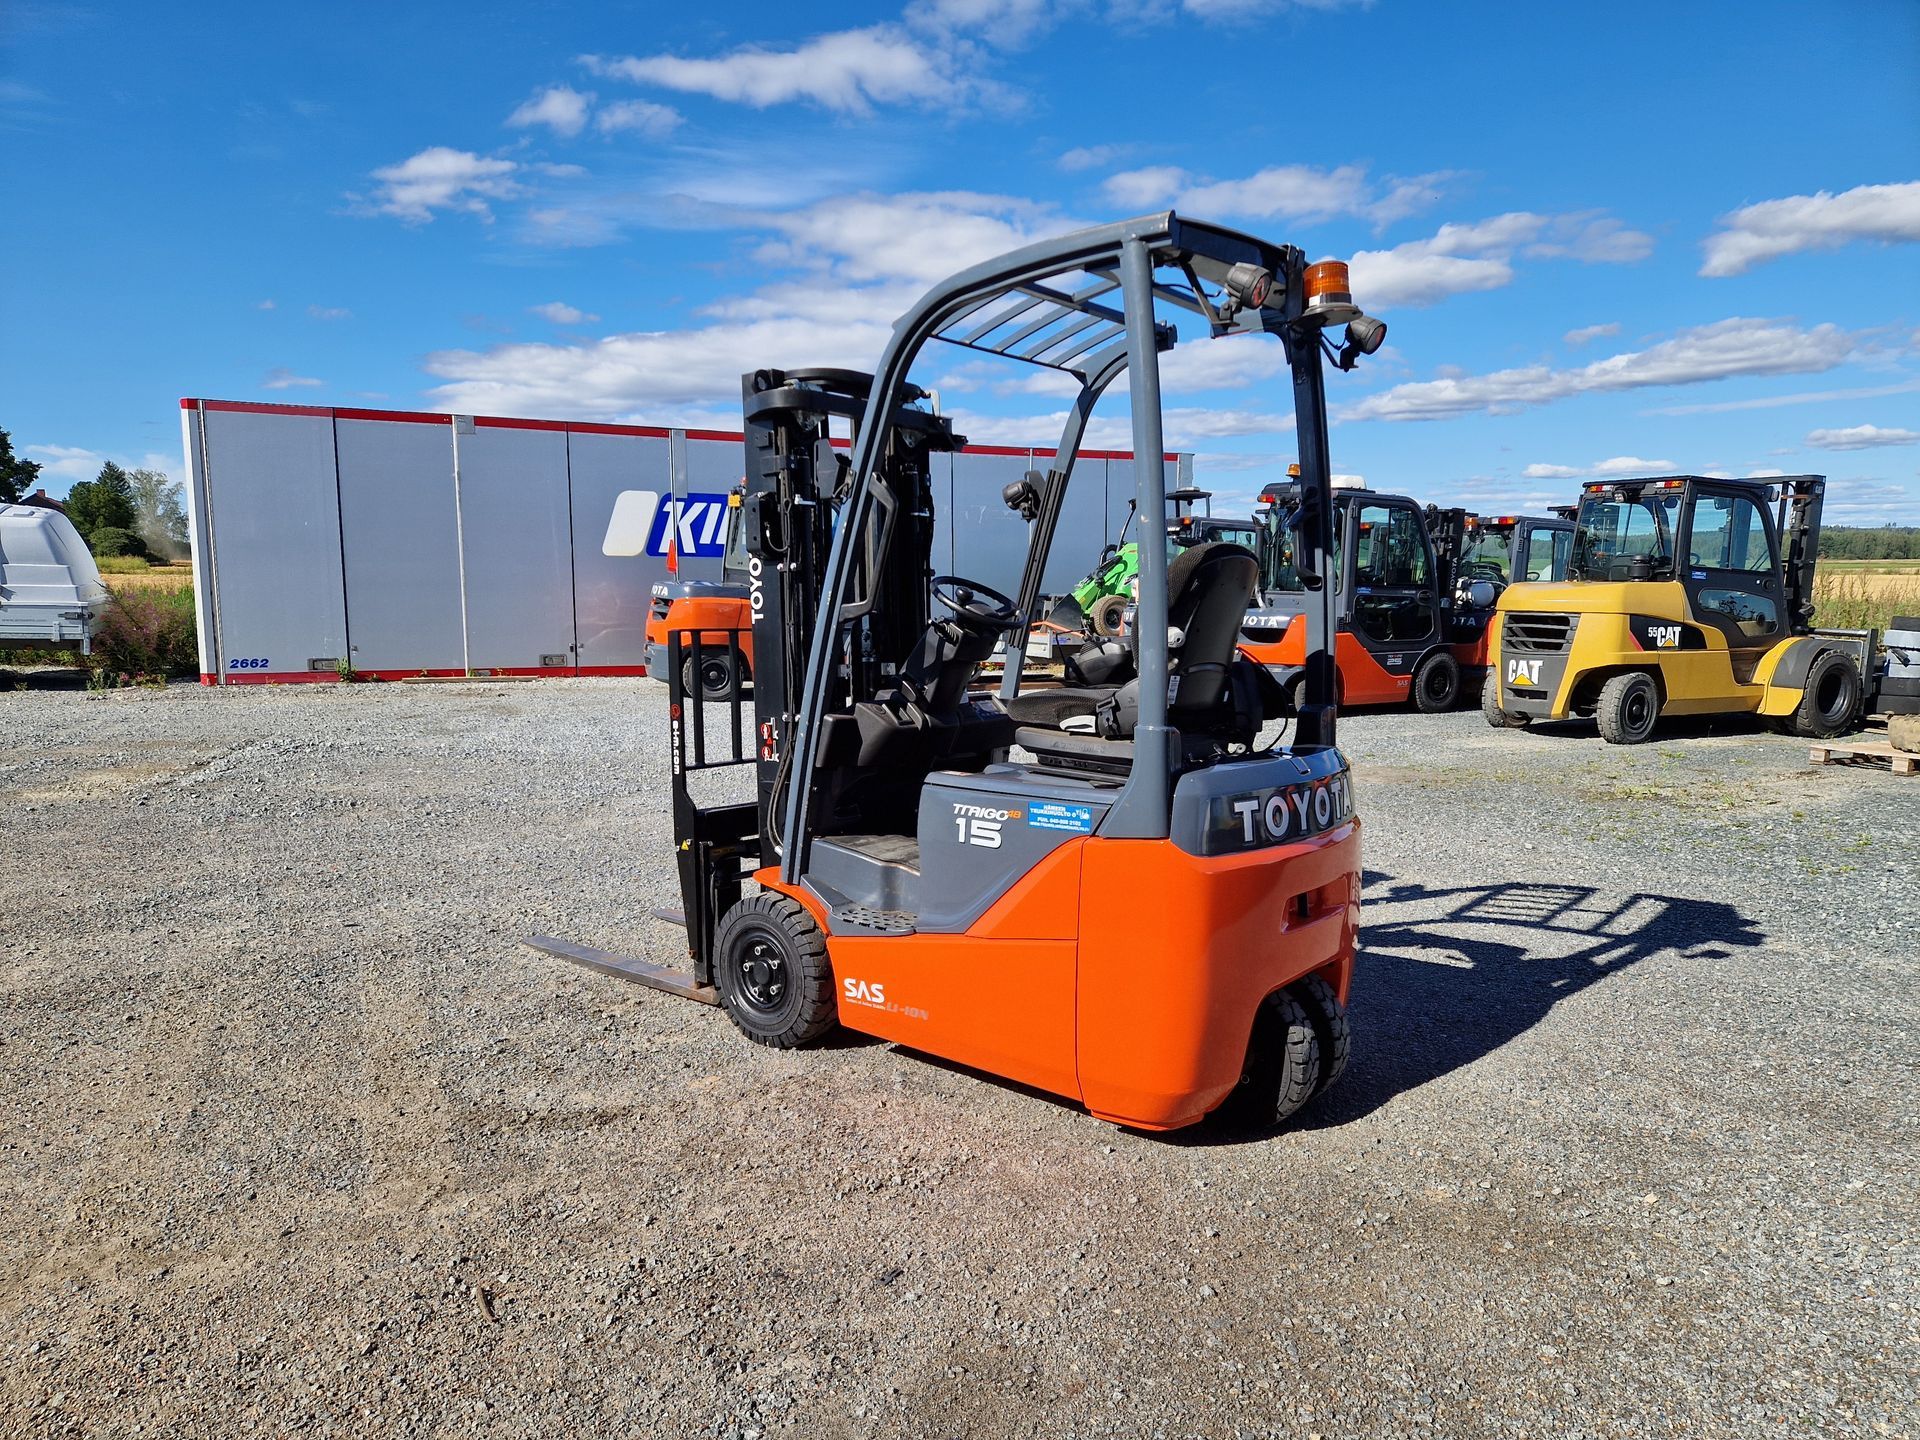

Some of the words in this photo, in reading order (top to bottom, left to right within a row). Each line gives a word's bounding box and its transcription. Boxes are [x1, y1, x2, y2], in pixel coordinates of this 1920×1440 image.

[749, 553, 764, 625] TOYO
[1648, 627, 1658, 638] 55
[1657, 626, 1682, 648] CAT
[229, 658, 269, 669] 2662
[1387, 657, 1403, 666] 25
[1508, 659, 1544, 686] CAT
[1233, 775, 1353, 843] TOYOTA
[955, 817, 1003, 849] 15
[844, 977, 885, 1004] SAS
